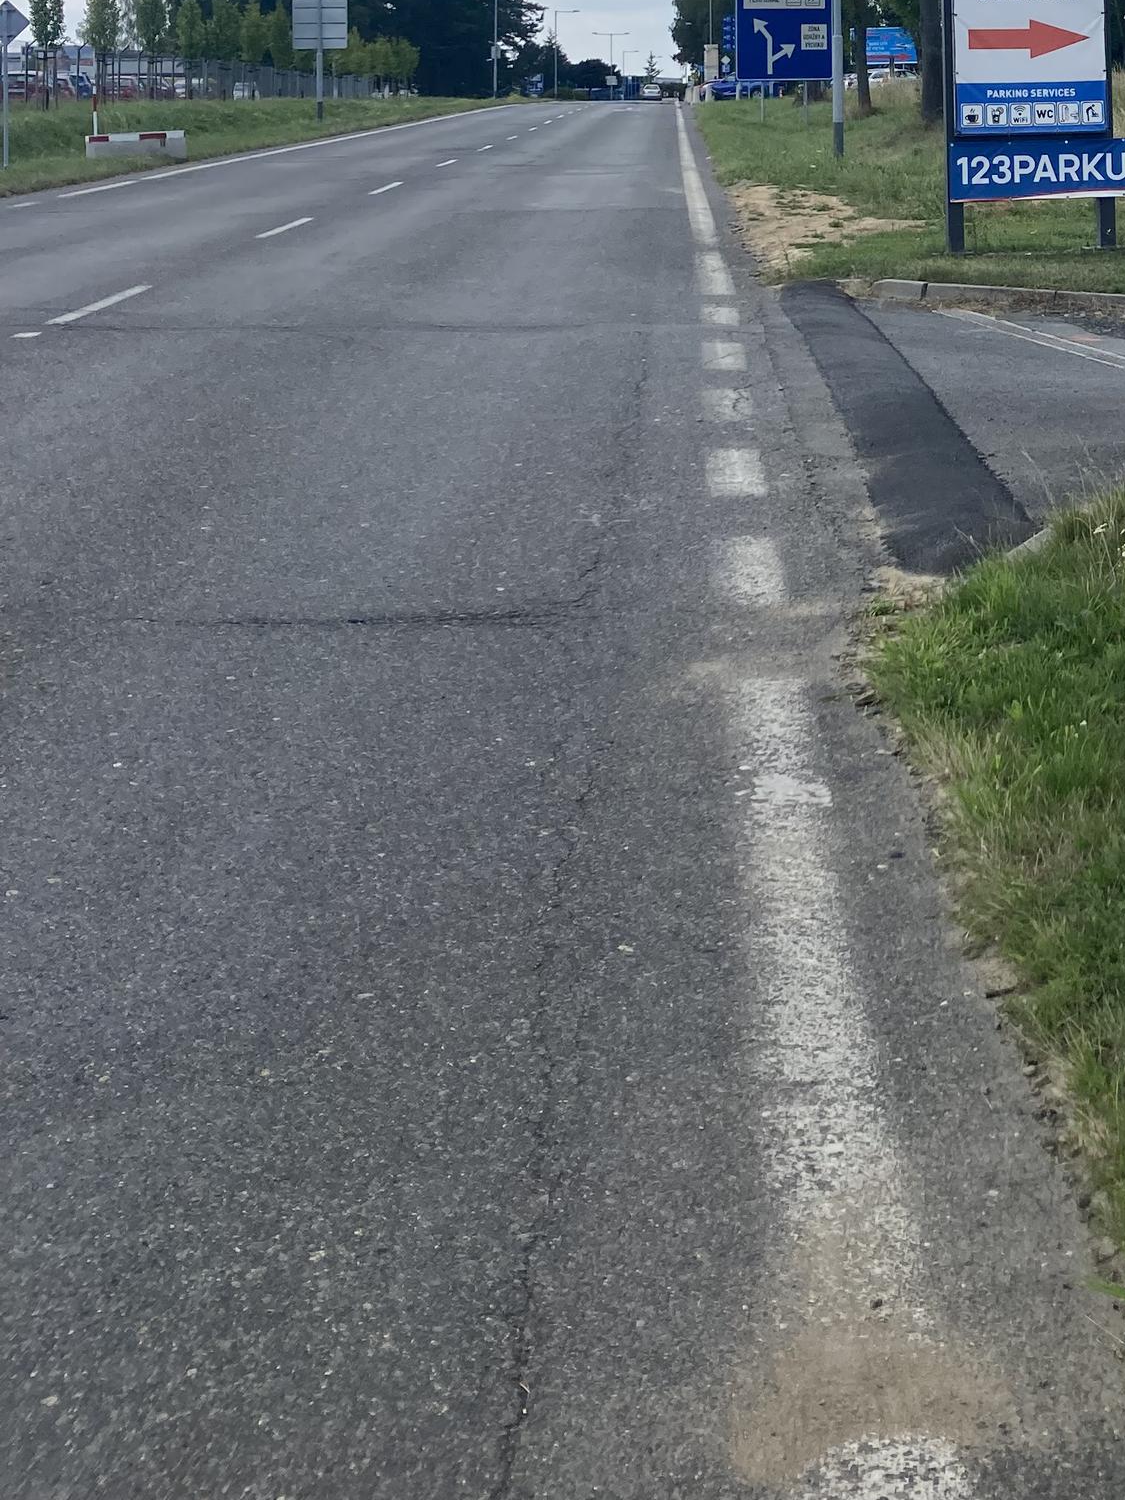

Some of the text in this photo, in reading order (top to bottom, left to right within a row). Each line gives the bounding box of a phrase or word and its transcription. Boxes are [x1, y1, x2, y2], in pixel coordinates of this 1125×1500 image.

[986, 88, 1076, 98] PARKING SERVICES
[1036, 109, 1054, 119] WC
